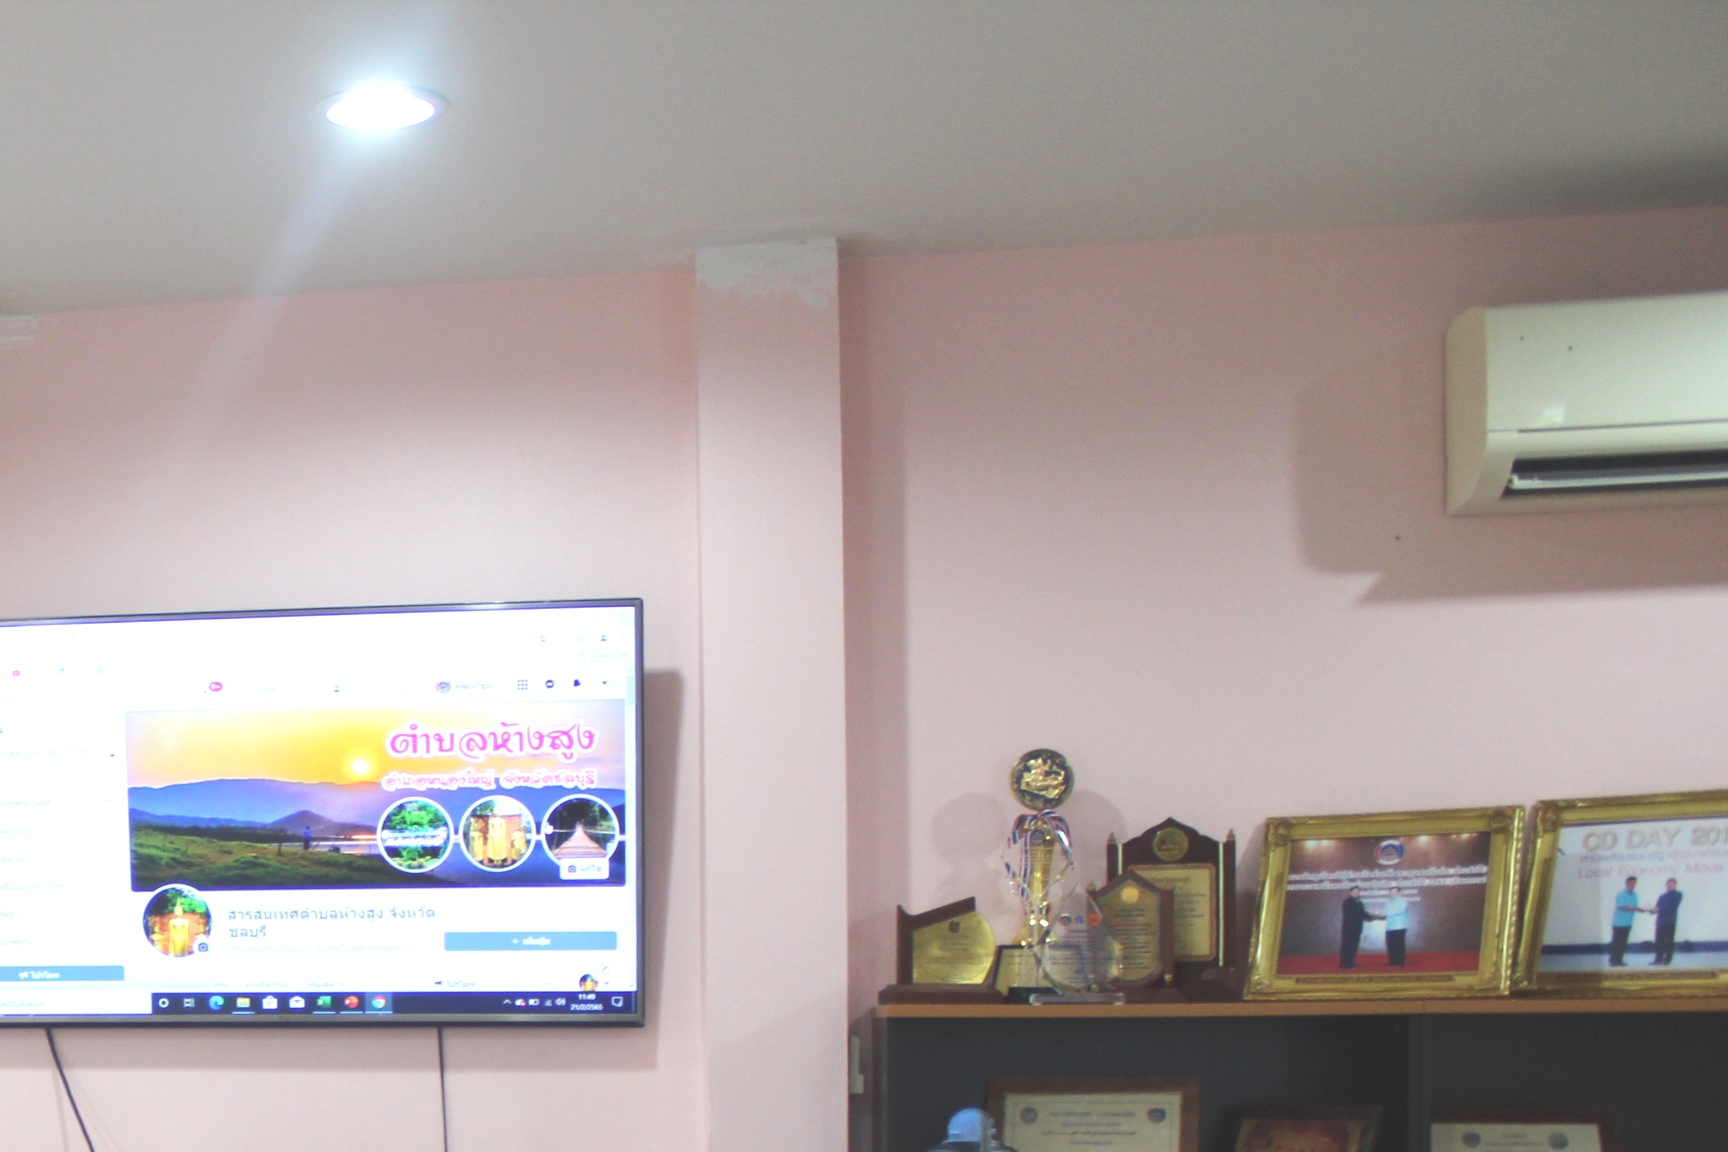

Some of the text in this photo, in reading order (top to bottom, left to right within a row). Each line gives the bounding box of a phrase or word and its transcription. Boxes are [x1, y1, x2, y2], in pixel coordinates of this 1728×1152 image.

[390, 722, 596, 760] ตำบลห้างสูง
[1626, 826, 1681, 849] DAY
[228, 906, 436, 921] สารสนเทศตำบลห้างสูง จังหวัด
[228, 925, 267, 940] ชลบุรี
